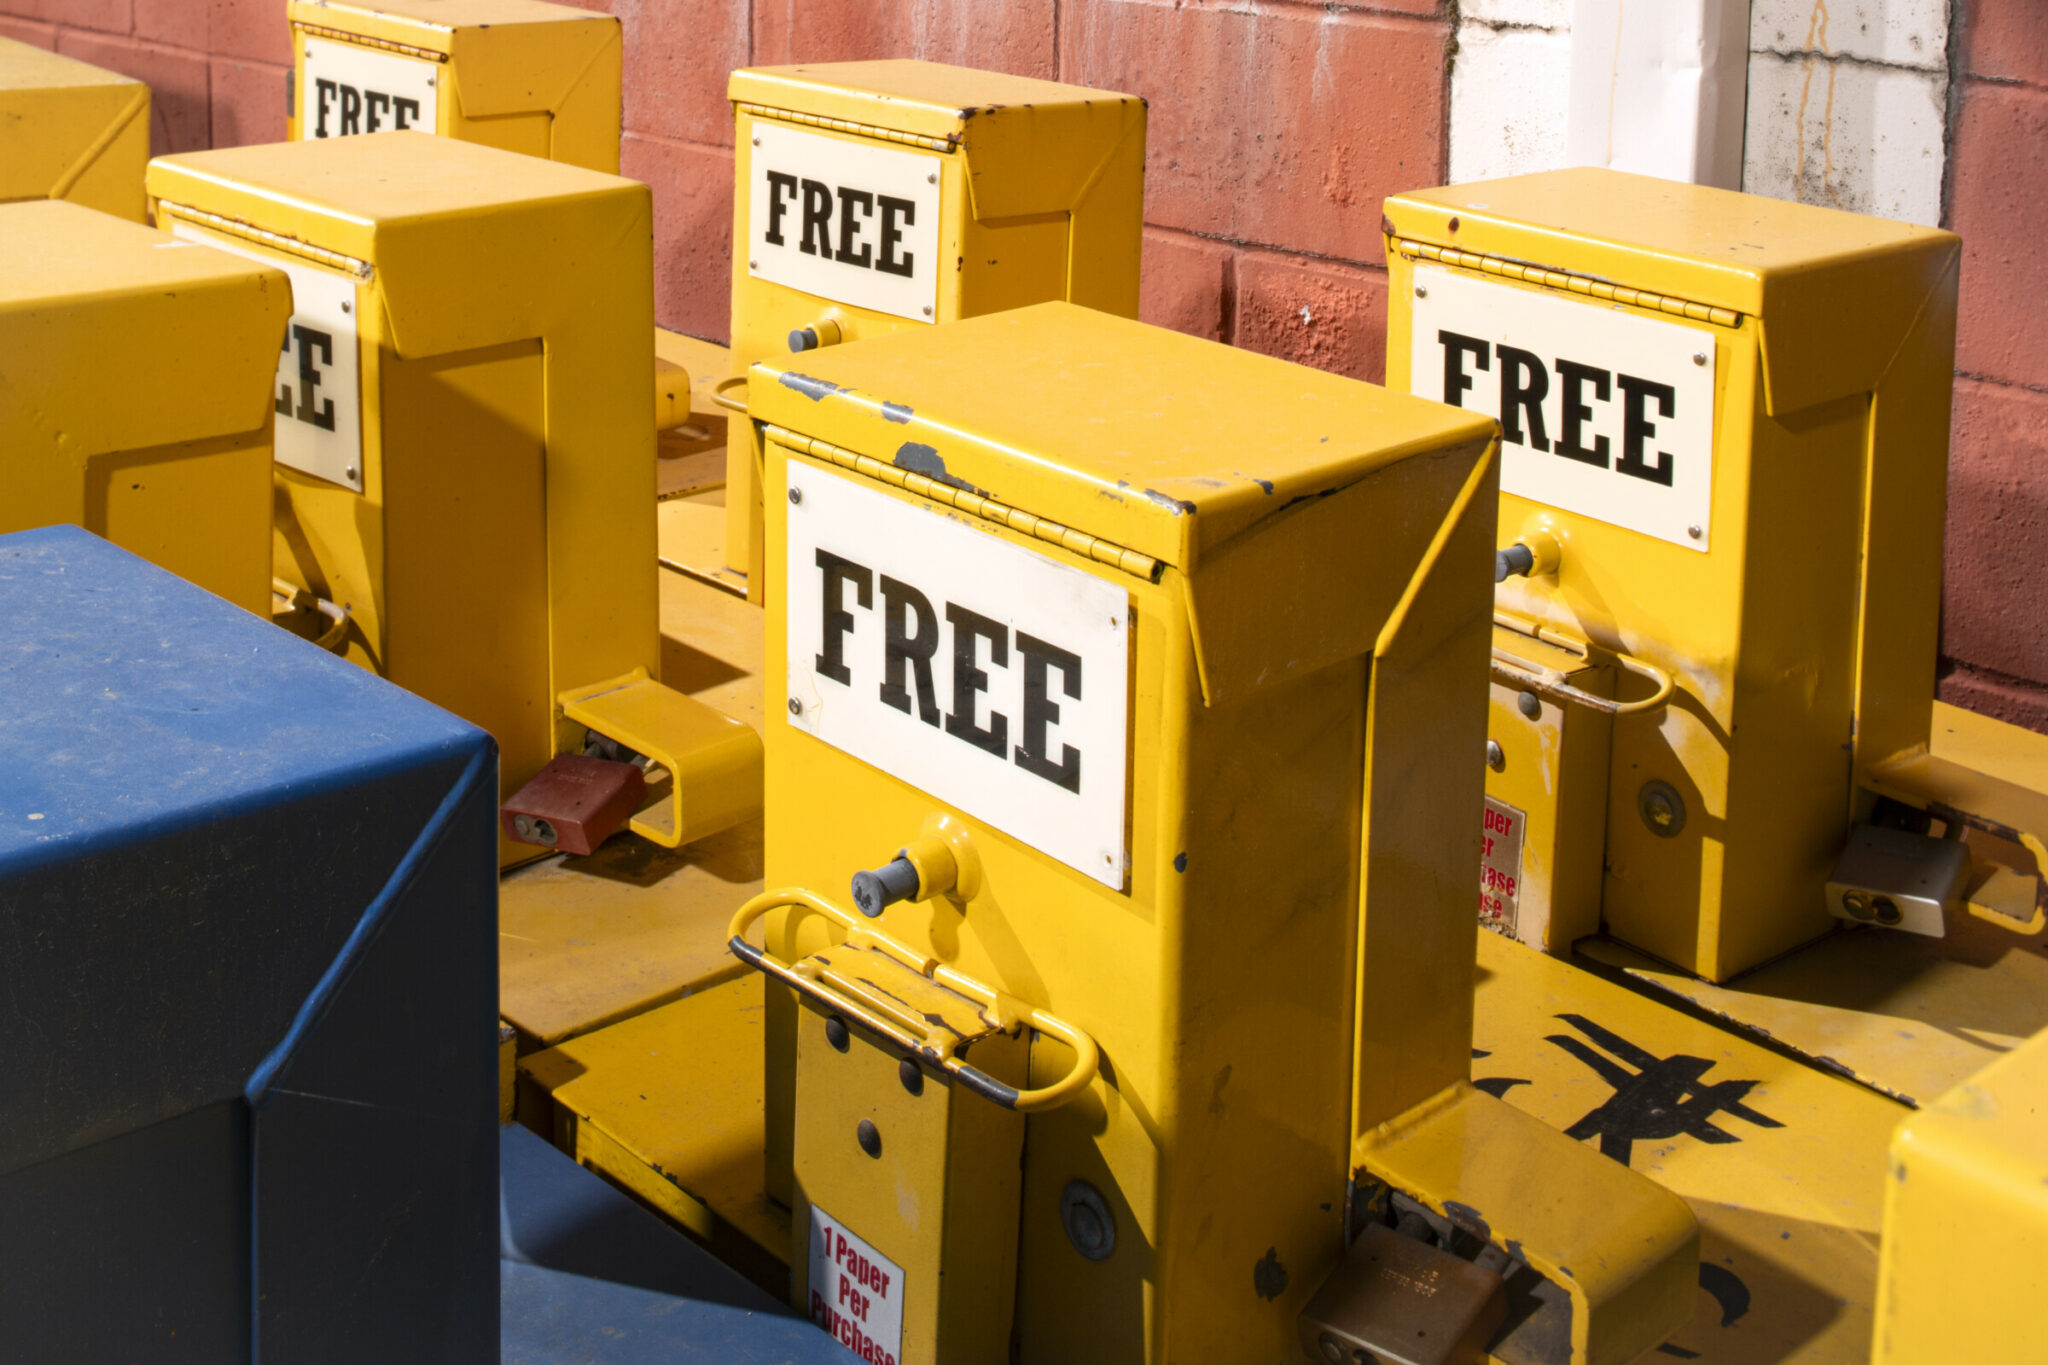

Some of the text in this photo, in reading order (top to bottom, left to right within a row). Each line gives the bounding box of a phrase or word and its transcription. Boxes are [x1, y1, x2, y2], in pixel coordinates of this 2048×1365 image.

[765, 169, 915, 278] FREE
[1438, 329, 1675, 487] FREE
[815, 547, 1082, 795] FREE
[824, 1227, 890, 1299] 1 Paper
[839, 1273, 870, 1323] Per
